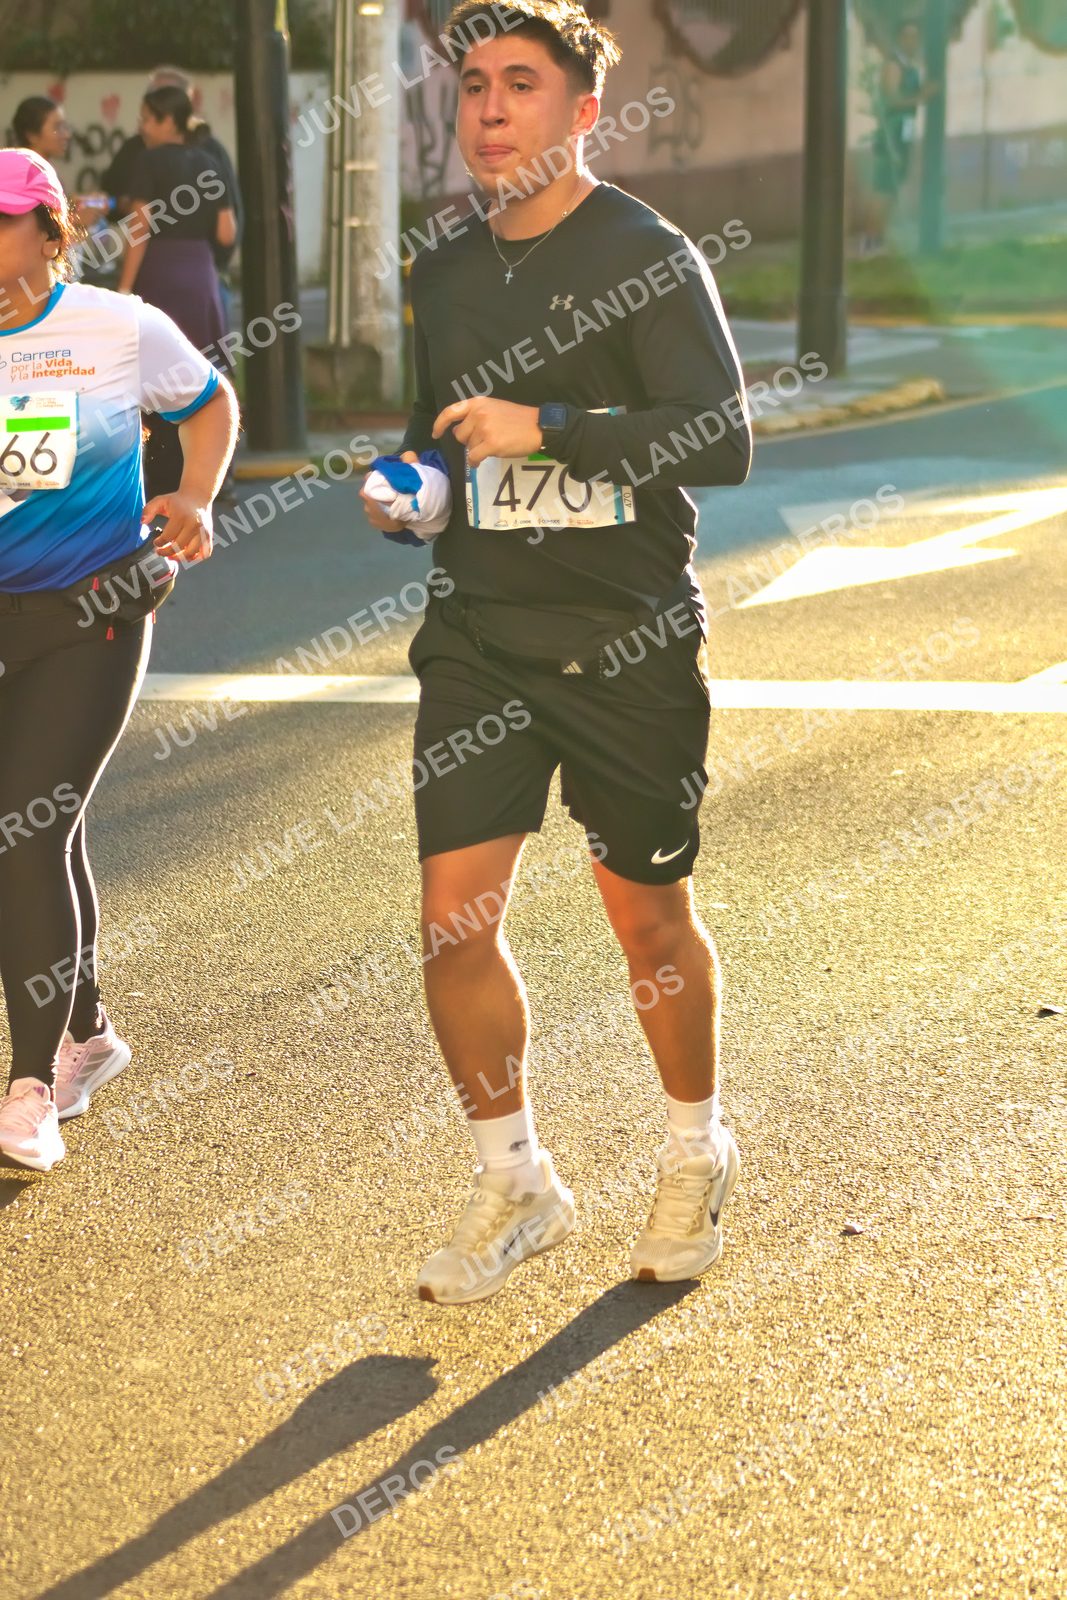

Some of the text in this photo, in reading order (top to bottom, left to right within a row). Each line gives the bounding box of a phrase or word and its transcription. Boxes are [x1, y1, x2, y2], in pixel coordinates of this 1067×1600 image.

[11, 349, 71, 363] Carrera
[10, 366, 95, 383] y la Integridad
[11, 358, 72, 375] por la Vida
[0, 432, 58, 477] 66
[493, 464, 592, 513] 470
[624, 492, 632, 508] 470
